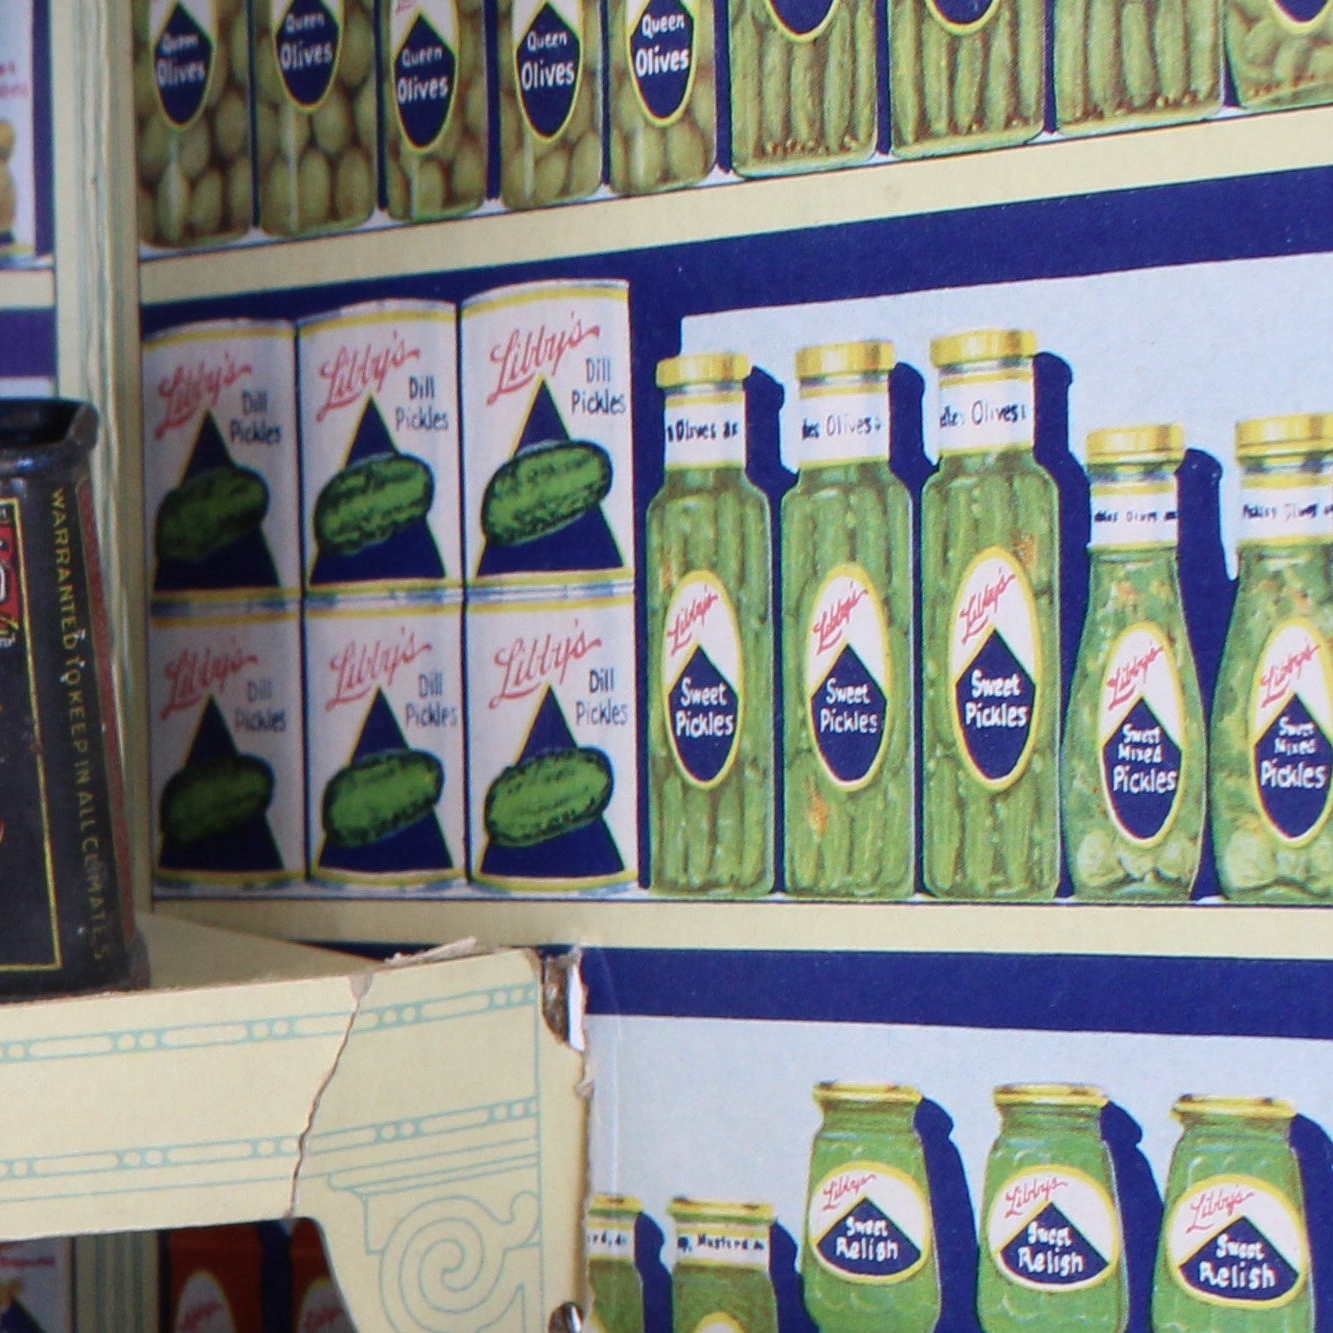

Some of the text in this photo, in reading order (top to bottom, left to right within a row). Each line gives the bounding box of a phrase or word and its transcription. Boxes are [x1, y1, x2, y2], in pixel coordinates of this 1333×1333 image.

[641, 13, 686, 35] Queen
[526, 30, 569, 52] Queen
[635, 45, 690, 80] Olives
[520, 61, 576, 94] Olives
[486, 311, 601, 405] Libby's
[585, 357, 613, 385] Dill
[571, 387, 628, 416] Pickles
[970, 667, 1020, 696] Sweet
[964, 702, 1028, 729] Pickles
[1112, 767, 1178, 793] Pickles
[1198, 1259, 1276, 1290] Relish
